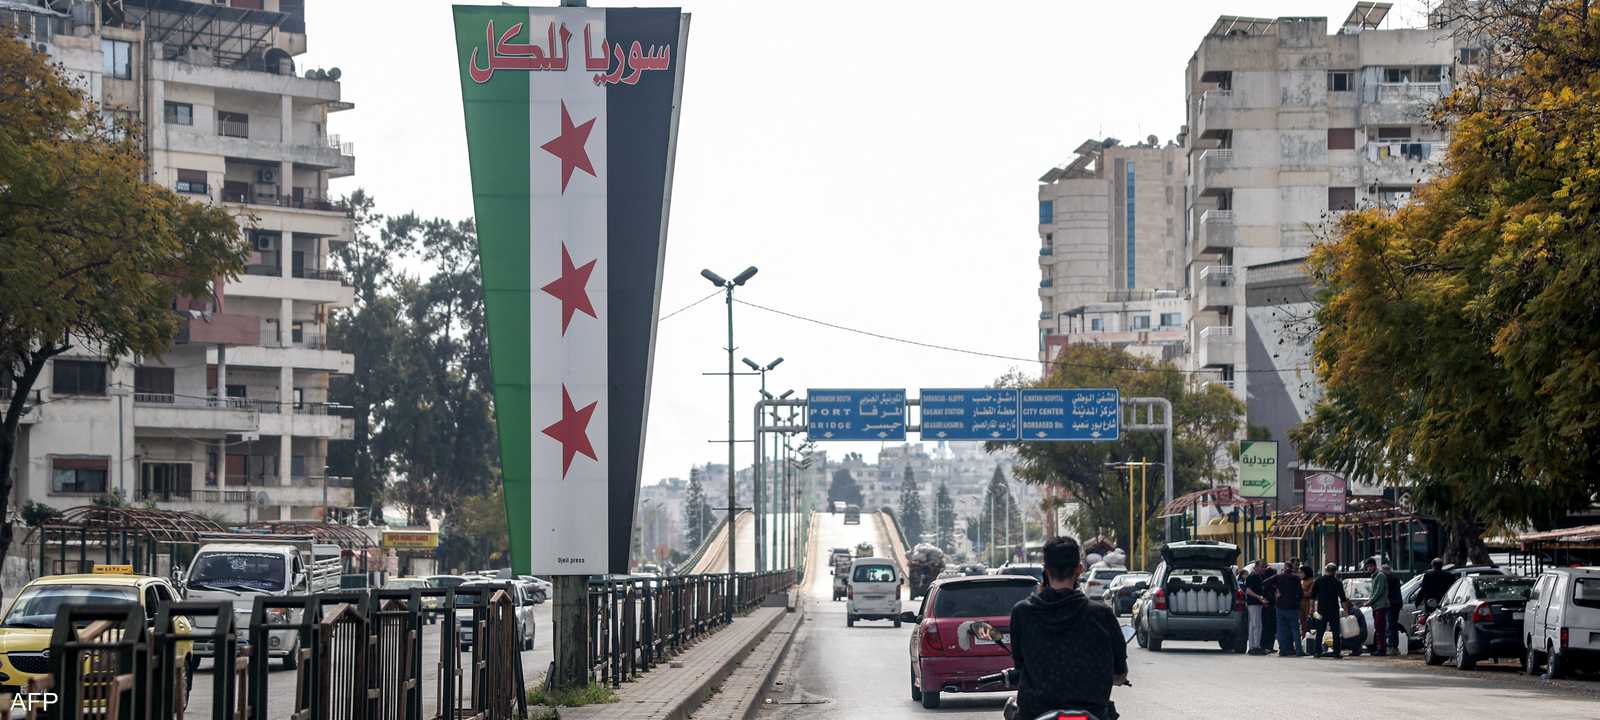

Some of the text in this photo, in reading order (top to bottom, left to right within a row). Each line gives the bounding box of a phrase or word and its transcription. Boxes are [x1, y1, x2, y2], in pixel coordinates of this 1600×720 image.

[469, 18, 671, 86] سوريا للكل
[810, 408, 852, 416] PORT
[996, 405, 1016, 415] محطة
[1023, 407, 1064, 415] CITY CENTER
[1071, 405, 1116, 418] مركز المدينة
[860, 422, 903, 432] جسر
[1102, 418, 1116, 431] شارع
[1242, 455, 1276, 468] صيدلية
